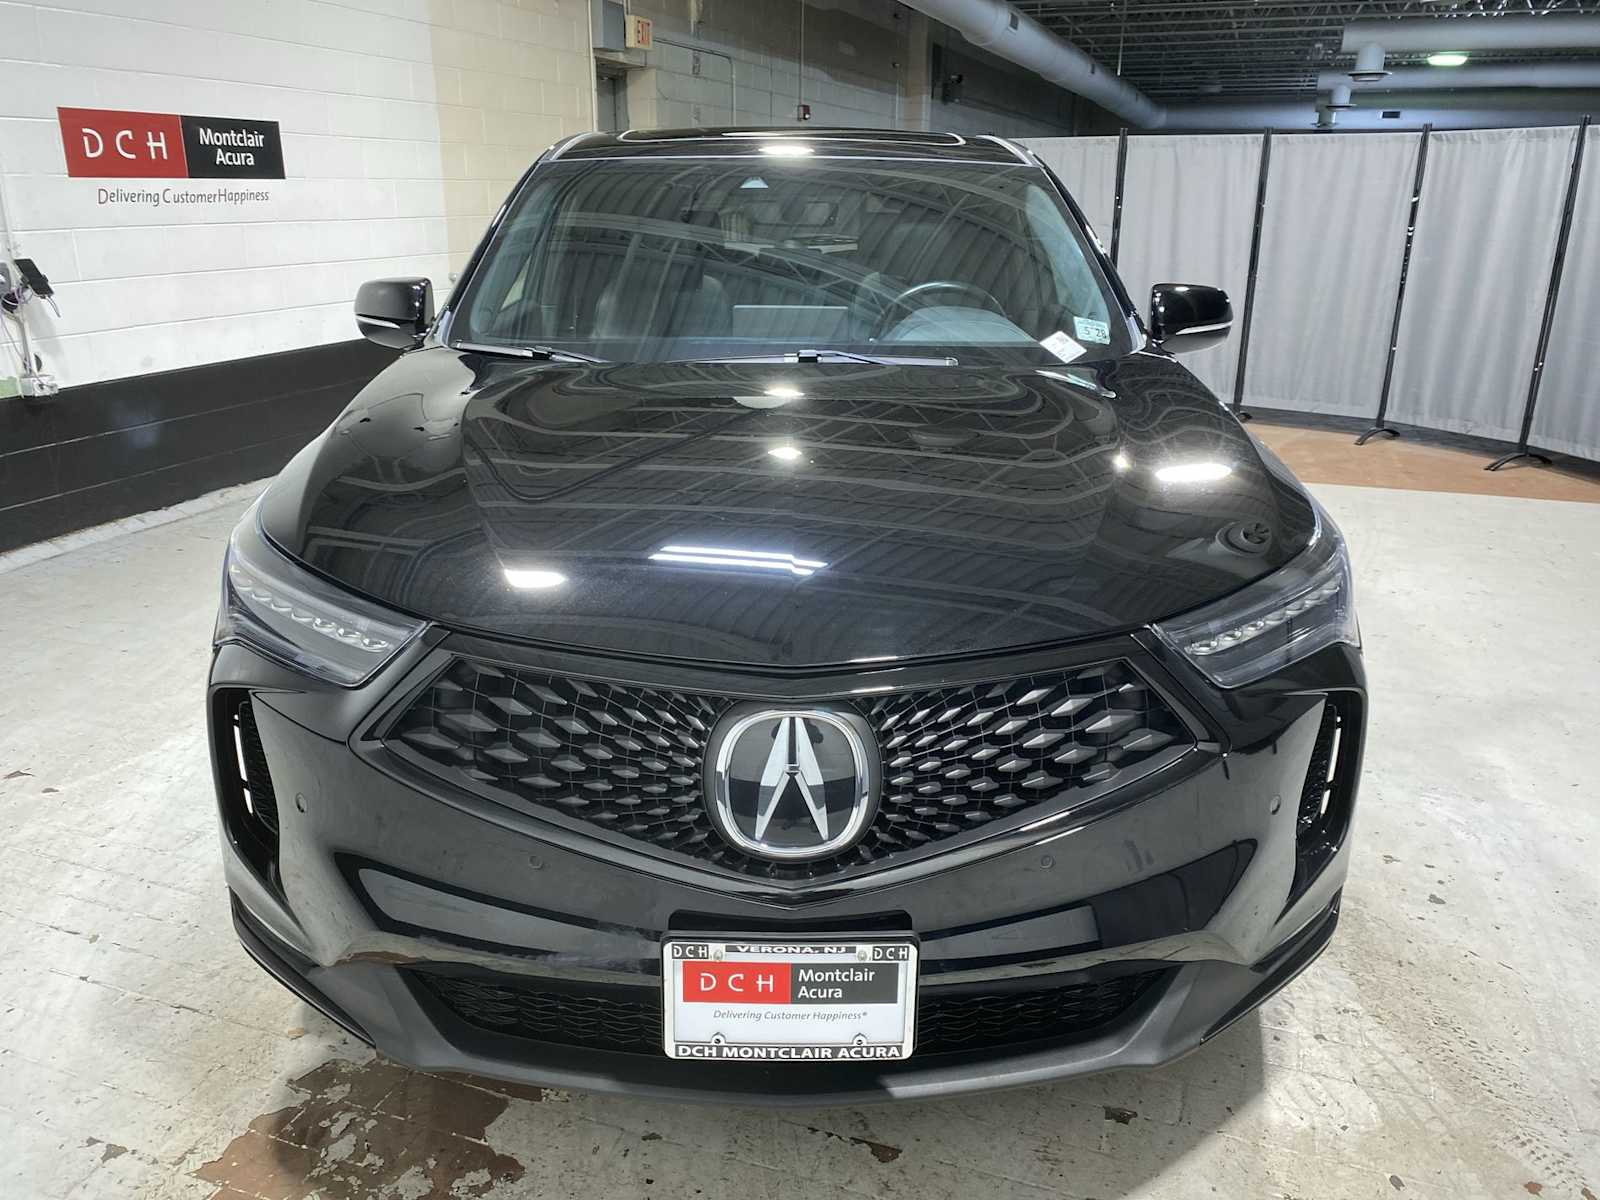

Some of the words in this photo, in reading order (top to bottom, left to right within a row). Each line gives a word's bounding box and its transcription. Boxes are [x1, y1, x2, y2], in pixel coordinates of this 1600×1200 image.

[199, 127, 265, 148] Montclair
[215, 149, 255, 166] Acura
[98, 188, 160, 207] Delivering
[673, 945, 708, 958] DCH
[736, 945, 819, 954] VERONA,
[823, 946, 846, 954] NJ
[873, 947, 908, 960] DCH
[798, 968, 876, 982] Montclair
[700, 972, 774, 993] DCH
[798, 985, 843, 999] Acura
[713, 1010, 762, 1021] Delivering
[764, 1011, 811, 1020] Customer
[678, 1045, 717, 1057] DCH
[722, 1046, 833, 1059] MONTCLAIR
[837, 1046, 900, 1058] ACURA
